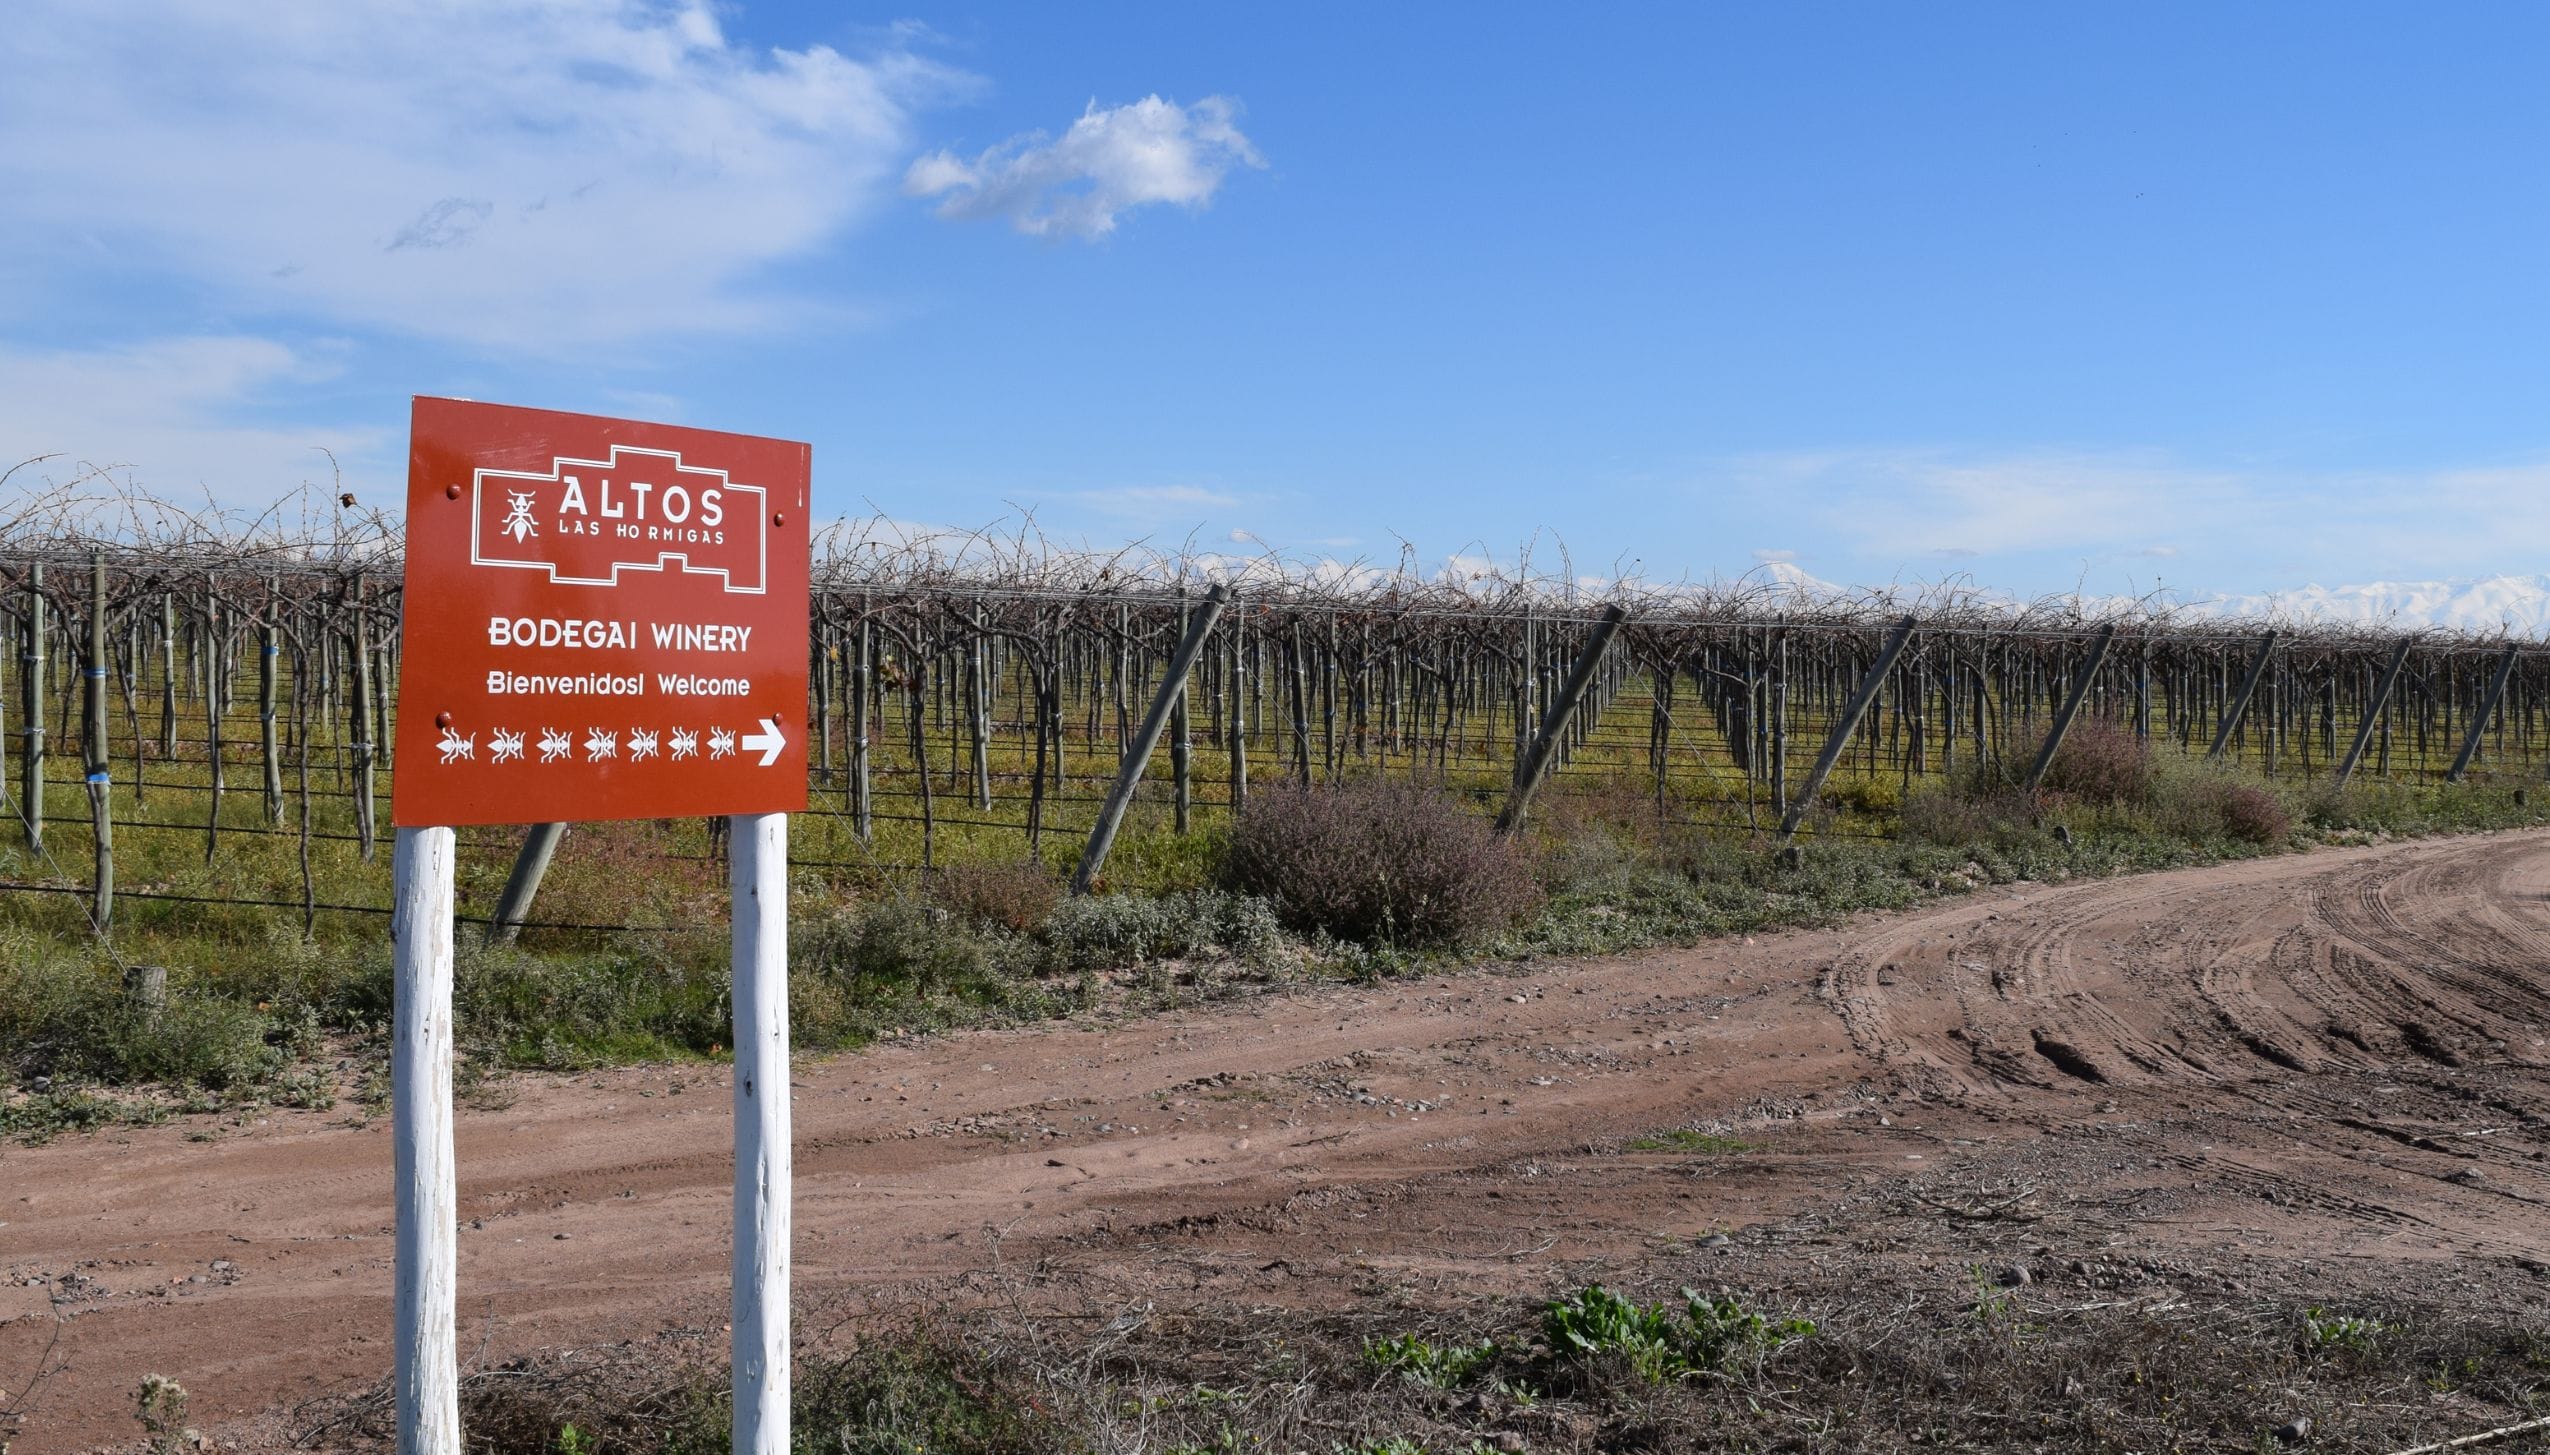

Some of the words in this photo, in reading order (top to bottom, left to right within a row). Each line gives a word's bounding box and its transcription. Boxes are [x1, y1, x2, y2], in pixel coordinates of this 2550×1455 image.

[559, 476, 723, 527] ALTOS
[559, 519, 600, 536] LAS
[651, 622, 752, 651] WINERY
[657, 673, 751, 696] Welcome
